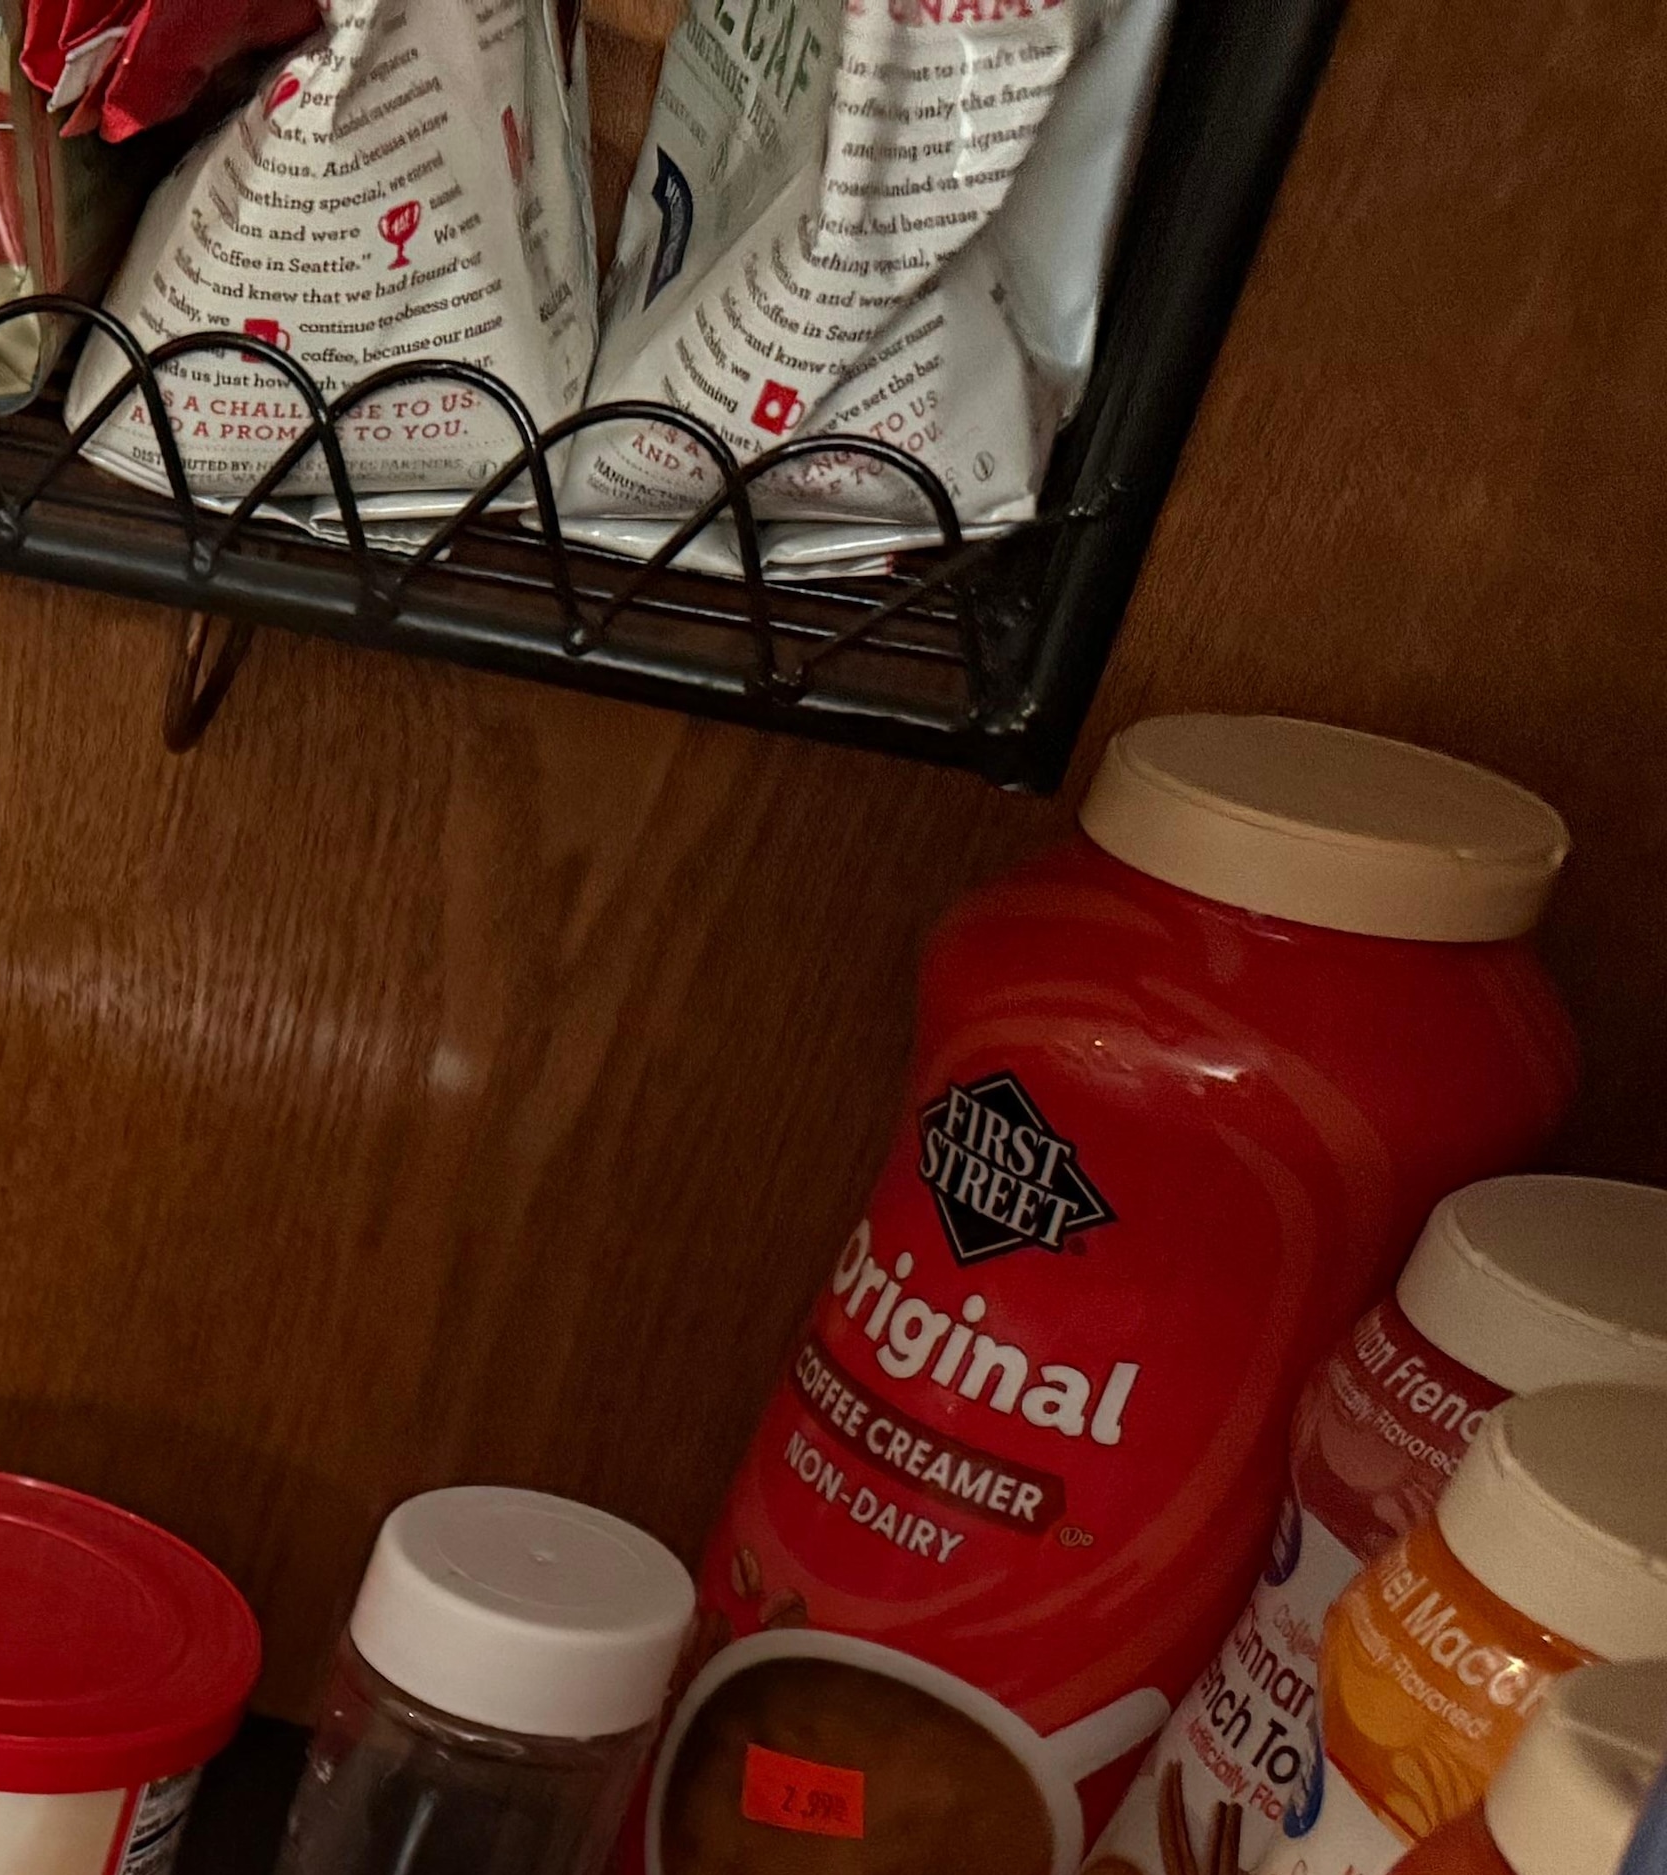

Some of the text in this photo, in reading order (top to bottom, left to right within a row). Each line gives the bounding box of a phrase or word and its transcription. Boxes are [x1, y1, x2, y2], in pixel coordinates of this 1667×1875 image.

[323, 154, 362, 178] And
[318, 181, 387, 212] special,
[268, 225, 361, 243] and were
[248, 282, 300, 303] knew
[302, 287, 341, 304] that
[344, 289, 372, 302] we
[375, 273, 408, 299] had
[410, 256, 458, 288] found
[266, 257, 285, 272] in
[207, 311, 231, 327] we
[298, 318, 376, 335] continue
[378, 316, 394, 330] to
[394, 299, 450, 323] obsess
[816, 291, 856, 308] and
[300, 314, 504, 365] coffee, because our name
[803, 322, 823, 339] in
[191, 367, 212, 383] us
[213, 370, 250, 387] just
[774, 345, 826, 374] knew
[887, 368, 915, 395] the
[130, 404, 184, 434] AD
[193, 421, 210, 438] A
[354, 425, 392, 441] TO
[403, 418, 469, 441] YOU.
[183, 395, 200, 413] A
[210, 399, 382, 420] CHALLGE
[392, 400, 430, 418] TO
[631, 432, 681, 471] AND
[943, 1085, 1079, 1190] FIRST
[919, 1127, 1080, 1248] STREET
[832, 1218, 1142, 1447] Original
[1382, 1355, 1489, 1445] Frenc
[794, 1343, 1045, 1523] COFFEE CREAMER
[783, 1429, 967, 1565] NON-DAIRY
